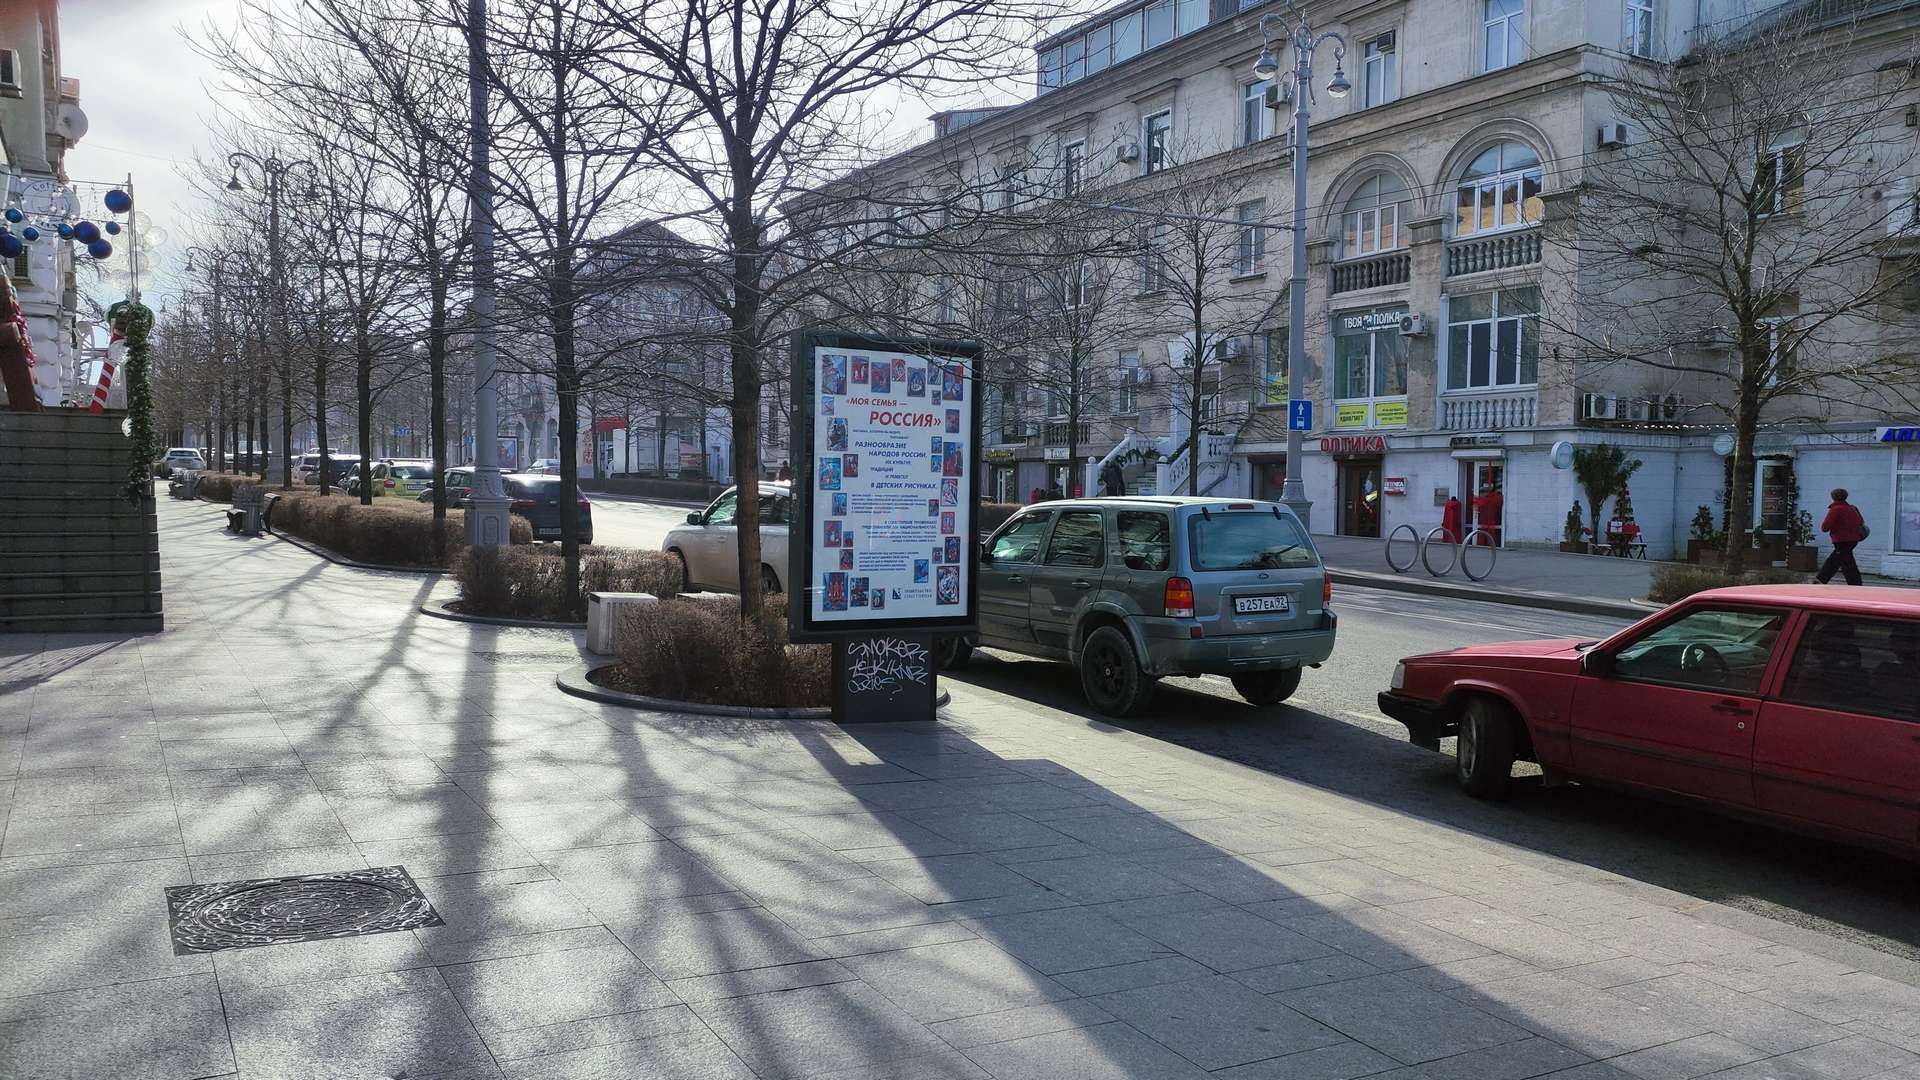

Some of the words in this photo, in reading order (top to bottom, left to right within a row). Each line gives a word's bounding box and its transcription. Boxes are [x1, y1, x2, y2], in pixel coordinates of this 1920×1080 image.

[1344, 316, 1362, 329] ТВОЯ
[1373, 311, 1400, 325] ПОЛКА
[847, 397, 869, 406] «МОЯ
[871, 398, 898, 407] СЕМЬЯ
[869, 411, 942, 428] РОССИЯ»
[855, 441, 907, 449] РАЗНООБРАЗИЕ
[1320, 435, 1387, 453] ОПТИКА
